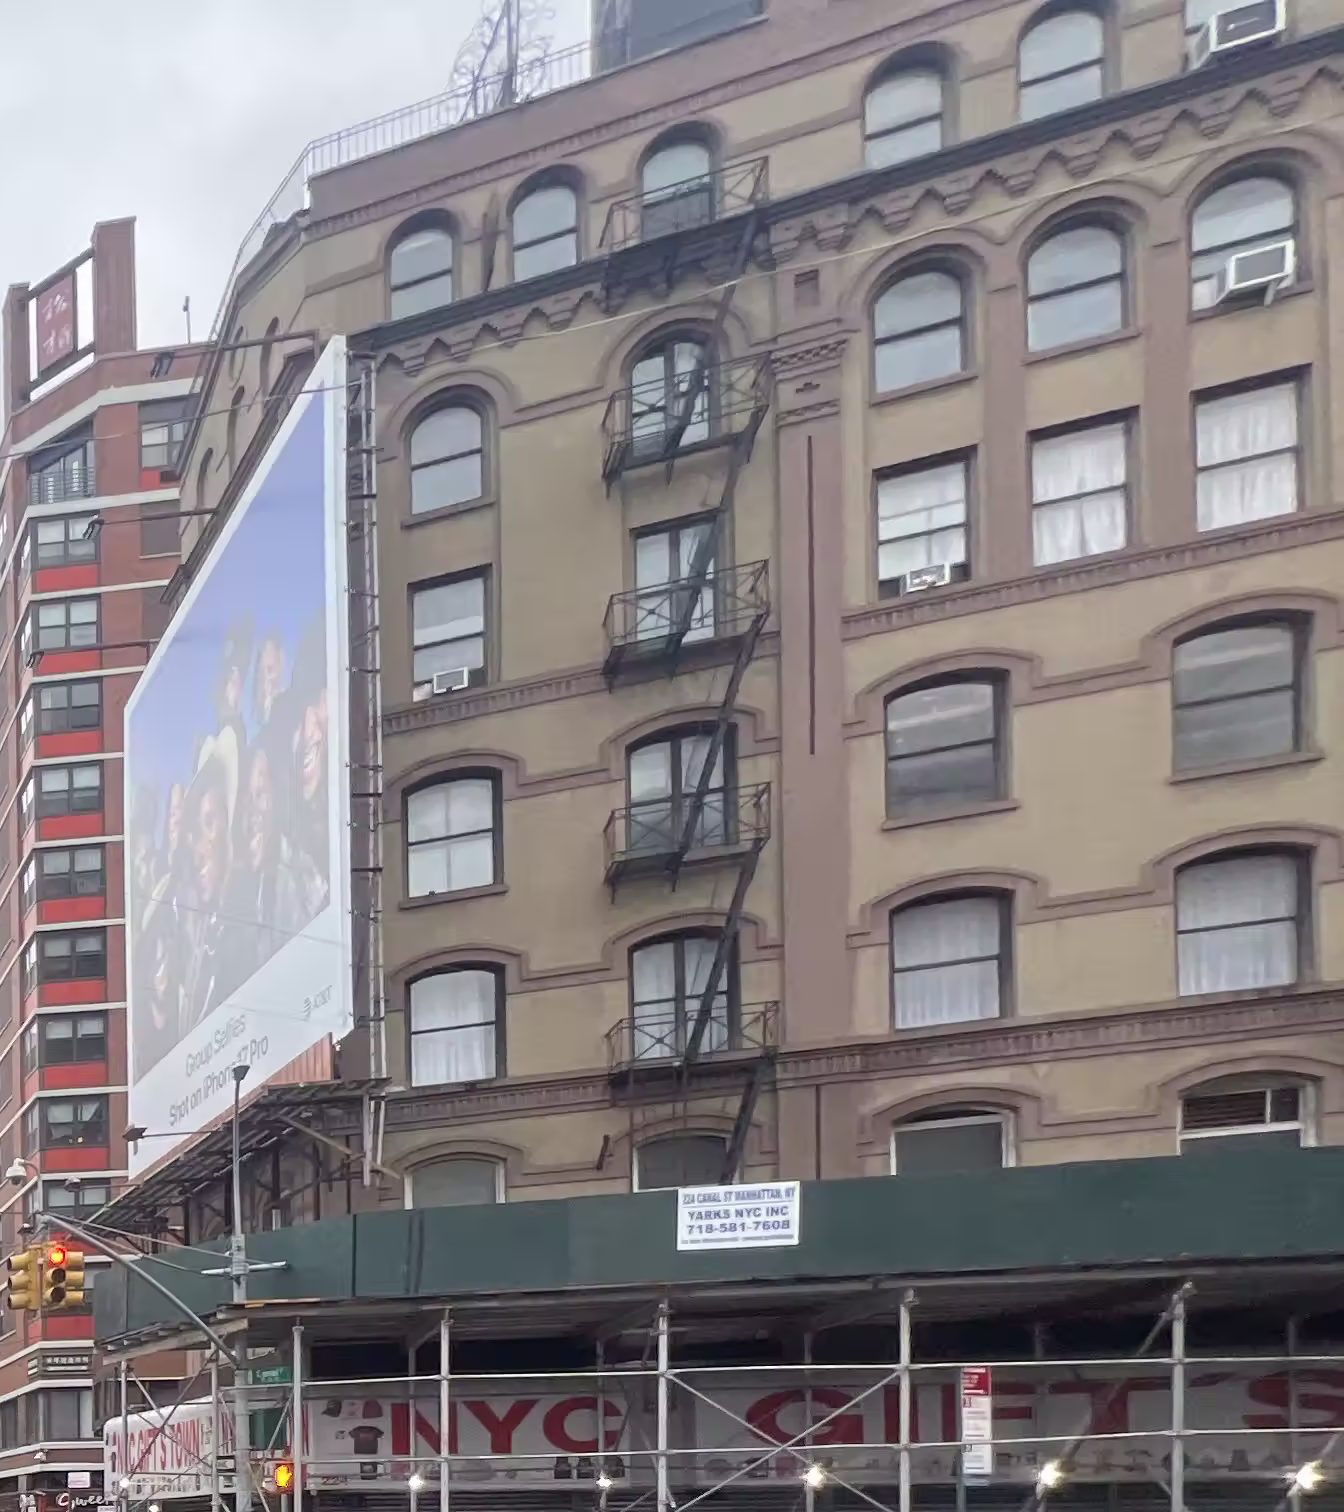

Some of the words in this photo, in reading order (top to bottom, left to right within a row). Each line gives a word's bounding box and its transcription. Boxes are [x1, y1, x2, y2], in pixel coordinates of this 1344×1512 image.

[184, 1042, 214, 1077] Group
[169, 1095, 190, 1127] Shot
[190, 1087, 202, 1114] on
[203, 1062, 237, 1101] iPhon
[249, 1036, 269, 1065] Pro
[686, 1219, 790, 1235] 718-581-7608
[687, 1209, 731, 1220] YARKS
[734, 1207, 762, 1219] NYC
[765, 1206, 789, 1217] INC
[390, 1396, 624, 1455] NYC
